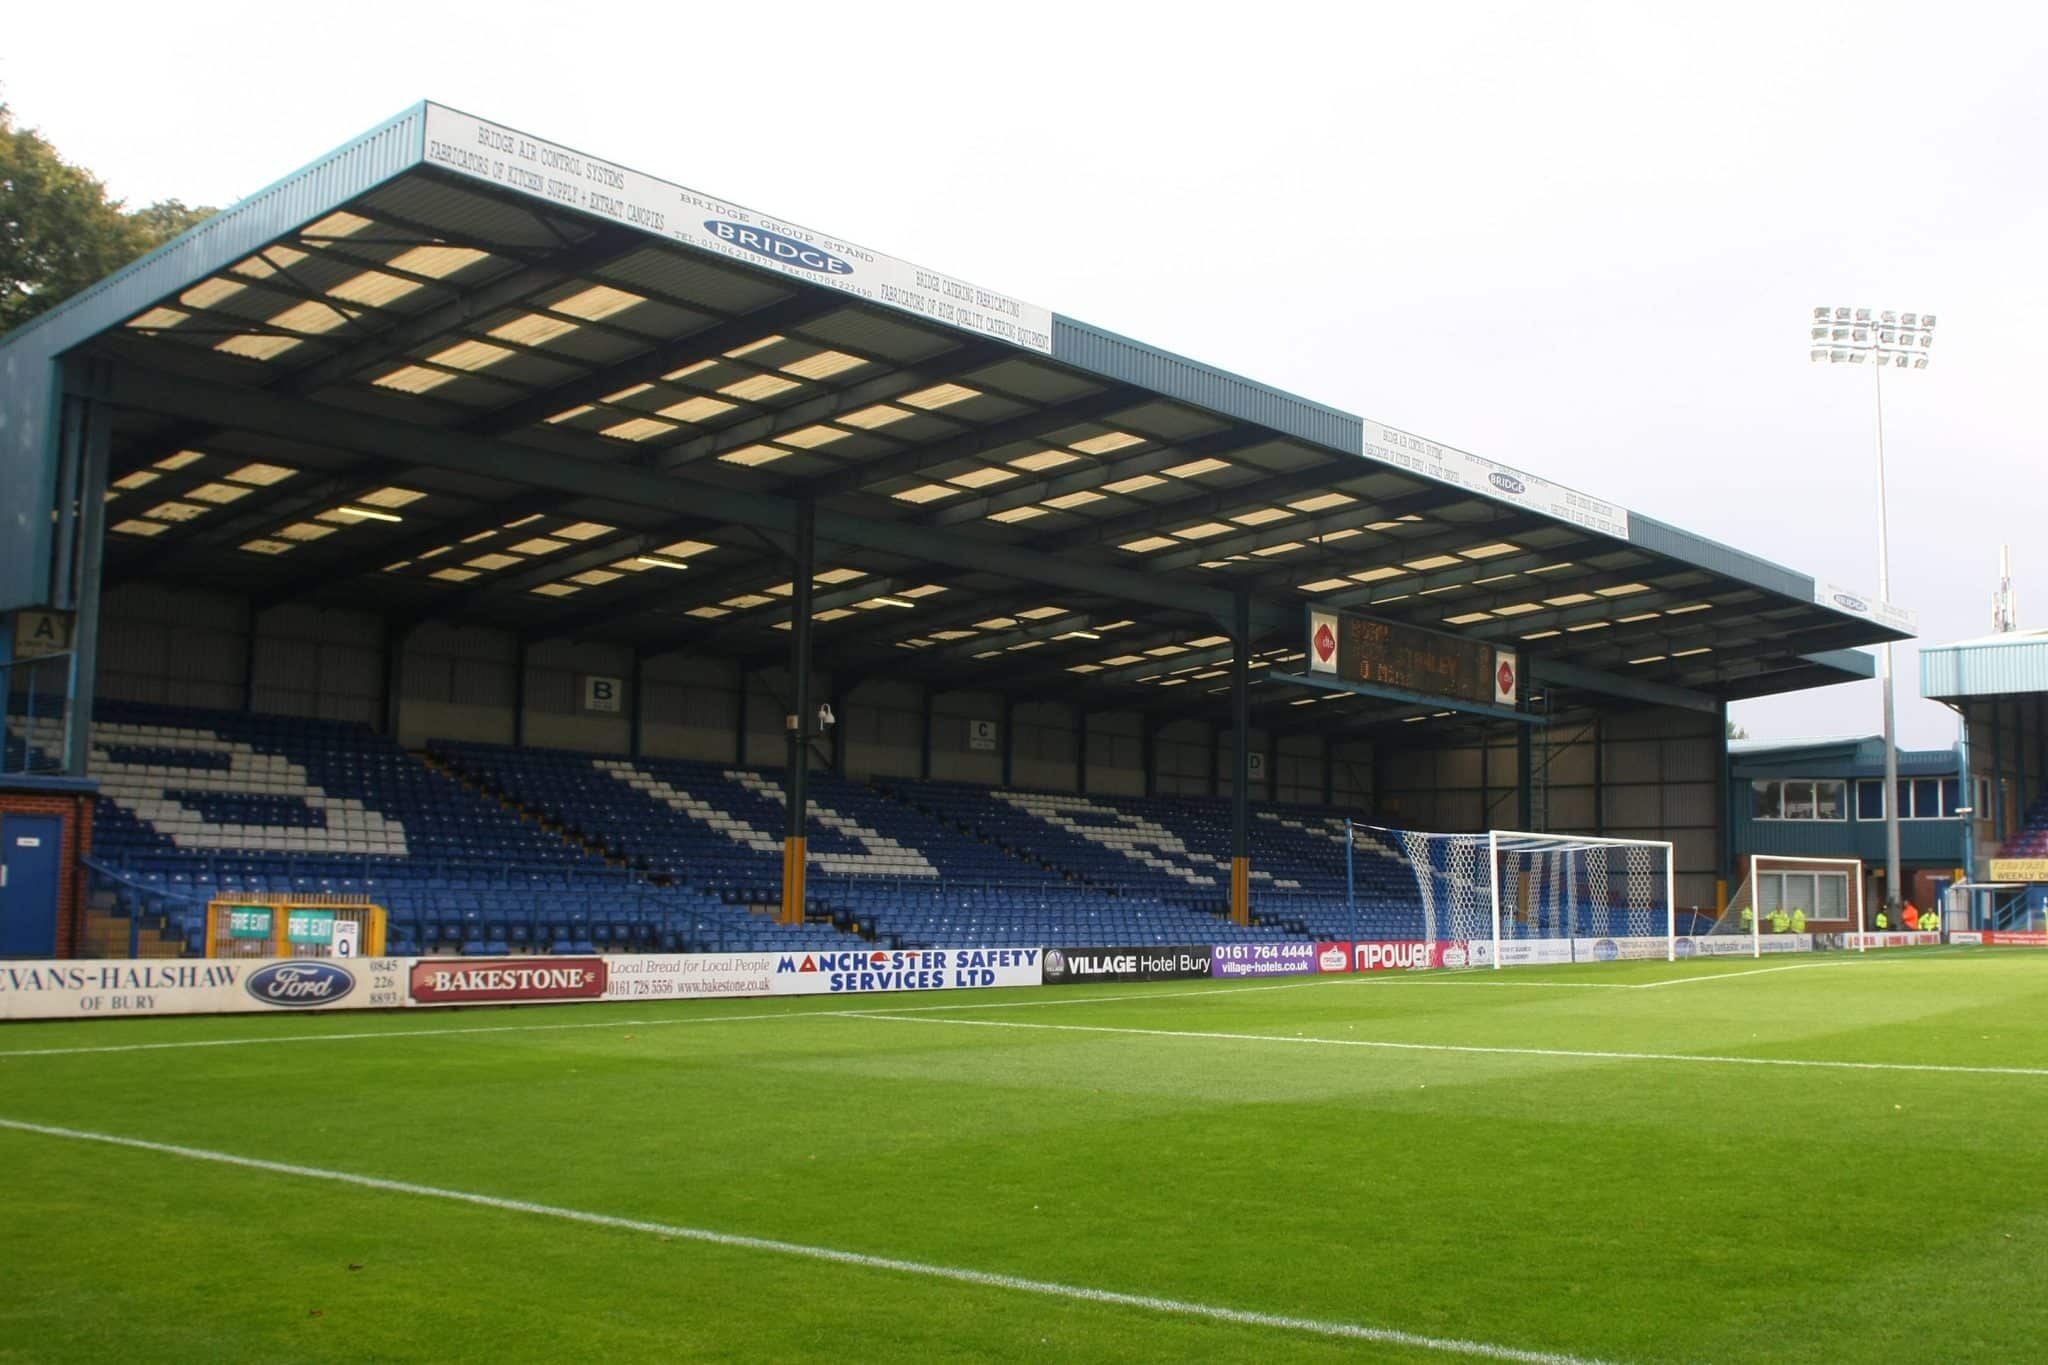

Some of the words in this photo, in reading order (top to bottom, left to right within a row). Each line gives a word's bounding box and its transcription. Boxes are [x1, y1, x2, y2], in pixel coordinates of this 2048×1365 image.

[478, 127, 514, 154] BRIDGE
[519, 140, 537, 161] AIR
[539, 148, 582, 177] CONTROL
[586, 162, 624, 190] SYSTEMS
[429, 140, 489, 175] FABRICATORS
[492, 160, 504, 180] OF
[507, 166, 544, 192] KITCHEN
[547, 178, 578, 203] SUPPLY
[589, 192, 624, 218] EXTRACT
[626, 203, 664, 231] CANOPIES
[680, 193, 749, 222] BRIDGE
[760, 219, 814, 241] GROUP
[823, 240, 874, 263] STAND
[716, 222, 845, 274] BRIDGE
[916, 270, 940, 292] BRIDGE
[942, 279, 974, 304] CATERING
[976, 290, 1020, 318] FABRICATIONS
[881, 283, 925, 313] FABRICATORS
[927, 298, 936, 315] OF
[938, 302, 954, 320] HIGH
[956, 307, 983, 329] QUALITY
[986, 316, 1016, 340] CATERING
[1490, 474, 1525, 493] BRIDGE
[33, 616, 54, 639] A
[594, 681, 612, 699] B
[979, 723, 988, 736] C
[1250, 755, 1260, 768] D
[231, 913, 249, 930] FIRE
[250, 914, 270, 931] EXIT
[289, 917, 309, 935] FIRE
[310, 918, 332, 936] EXIT
[336, 923, 355, 934] GATE
[338, 939, 350, 957] 9
[1215, 946, 1248, 959] 0161
[1253, 945, 1278, 959] 764
[1281, 944, 1313, 958] 4444
[610, 960, 642, 974] Local
[646, 959, 679, 973] Bread
[682, 959, 698, 975] for
[702, 959, 732, 972] Local
[735, 958, 770, 974] People
[777, 950, 947, 974] MANCHESTER
[956, 950, 1038, 968] SAFETY
[1068, 956, 1137, 974] VILLAGE
[1140, 954, 1176, 972] Hotel
[1180, 954, 1211, 973] Bury
[1222, 960, 1308, 975] village-hotels.co.uk
[268, 966, 335, 997] Ford
[374, 978, 394, 989] 226
[434, 968, 584, 992] BAKESTONE
[608, 980, 630, 995] 0161
[634, 980, 649, 995] 728
[677, 977, 770, 994] www.bakestone.co.uk
[830, 971, 944, 991] SERVICES
[955, 969, 996, 987] LTD
[80, 997, 102, 1010] OF
[112, 995, 158, 1009] BURY
